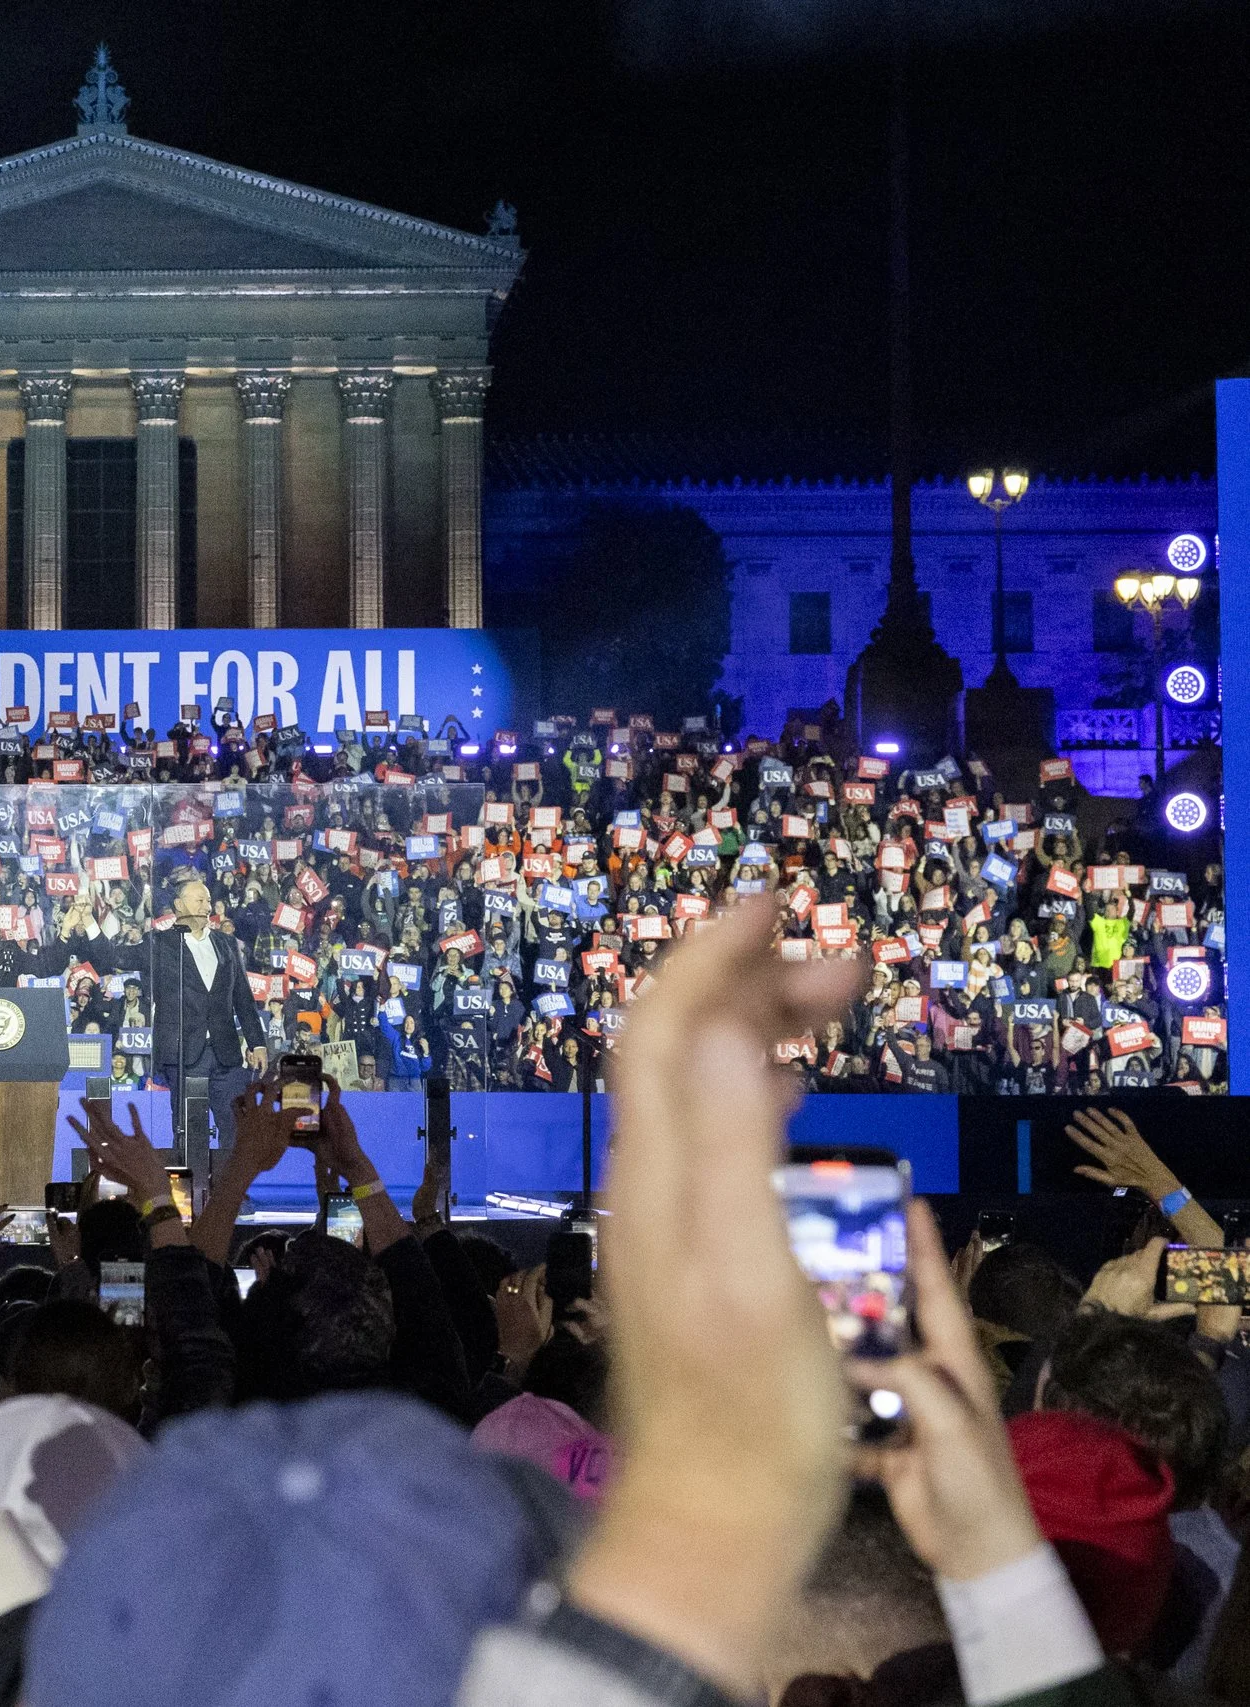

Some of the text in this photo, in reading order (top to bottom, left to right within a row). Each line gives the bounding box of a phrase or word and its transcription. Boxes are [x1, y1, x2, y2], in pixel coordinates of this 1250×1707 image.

[178, 650, 298, 732] FOR
[317, 650, 429, 732] ALL
[84, 717, 103, 729] USA
[278, 729, 300, 741] USA
[574, 736, 592, 745] USA
[656, 736, 677, 745] USA
[1, 742, 21, 751] USA
[56, 737, 74, 748] USA
[130, 757, 152, 767] USA
[579, 767, 600, 778] USA
[764, 771, 791, 782] USA
[917, 774, 945, 787] USA
[846, 788, 873, 799] USA
[893, 801, 918, 813] USA
[28, 812, 54, 824] USA
[58, 810, 90, 831] USA
[1045, 818, 1072, 831] USA
[239, 844, 269, 859] USA
[687, 849, 715, 862] USA
[211, 855, 233, 868] USA
[524, 858, 551, 872] USA
[48, 878, 78, 890] USA
[1153, 876, 1184, 890] USA
[485, 895, 514, 912] USA
[342, 955, 375, 971] USA
[537, 964, 566, 981] USA
[34, 978, 60, 988] VOTE FOR
[457, 996, 489, 1010] USA
[1014, 1004, 1052, 1019] USA
[1105, 1009, 1141, 1023] USA
[1188, 1021, 1222, 1032] HARRIS
[122, 1033, 151, 1048] USA
[777, 1043, 815, 1059] USA
[1116, 1076, 1149, 1087] USA
